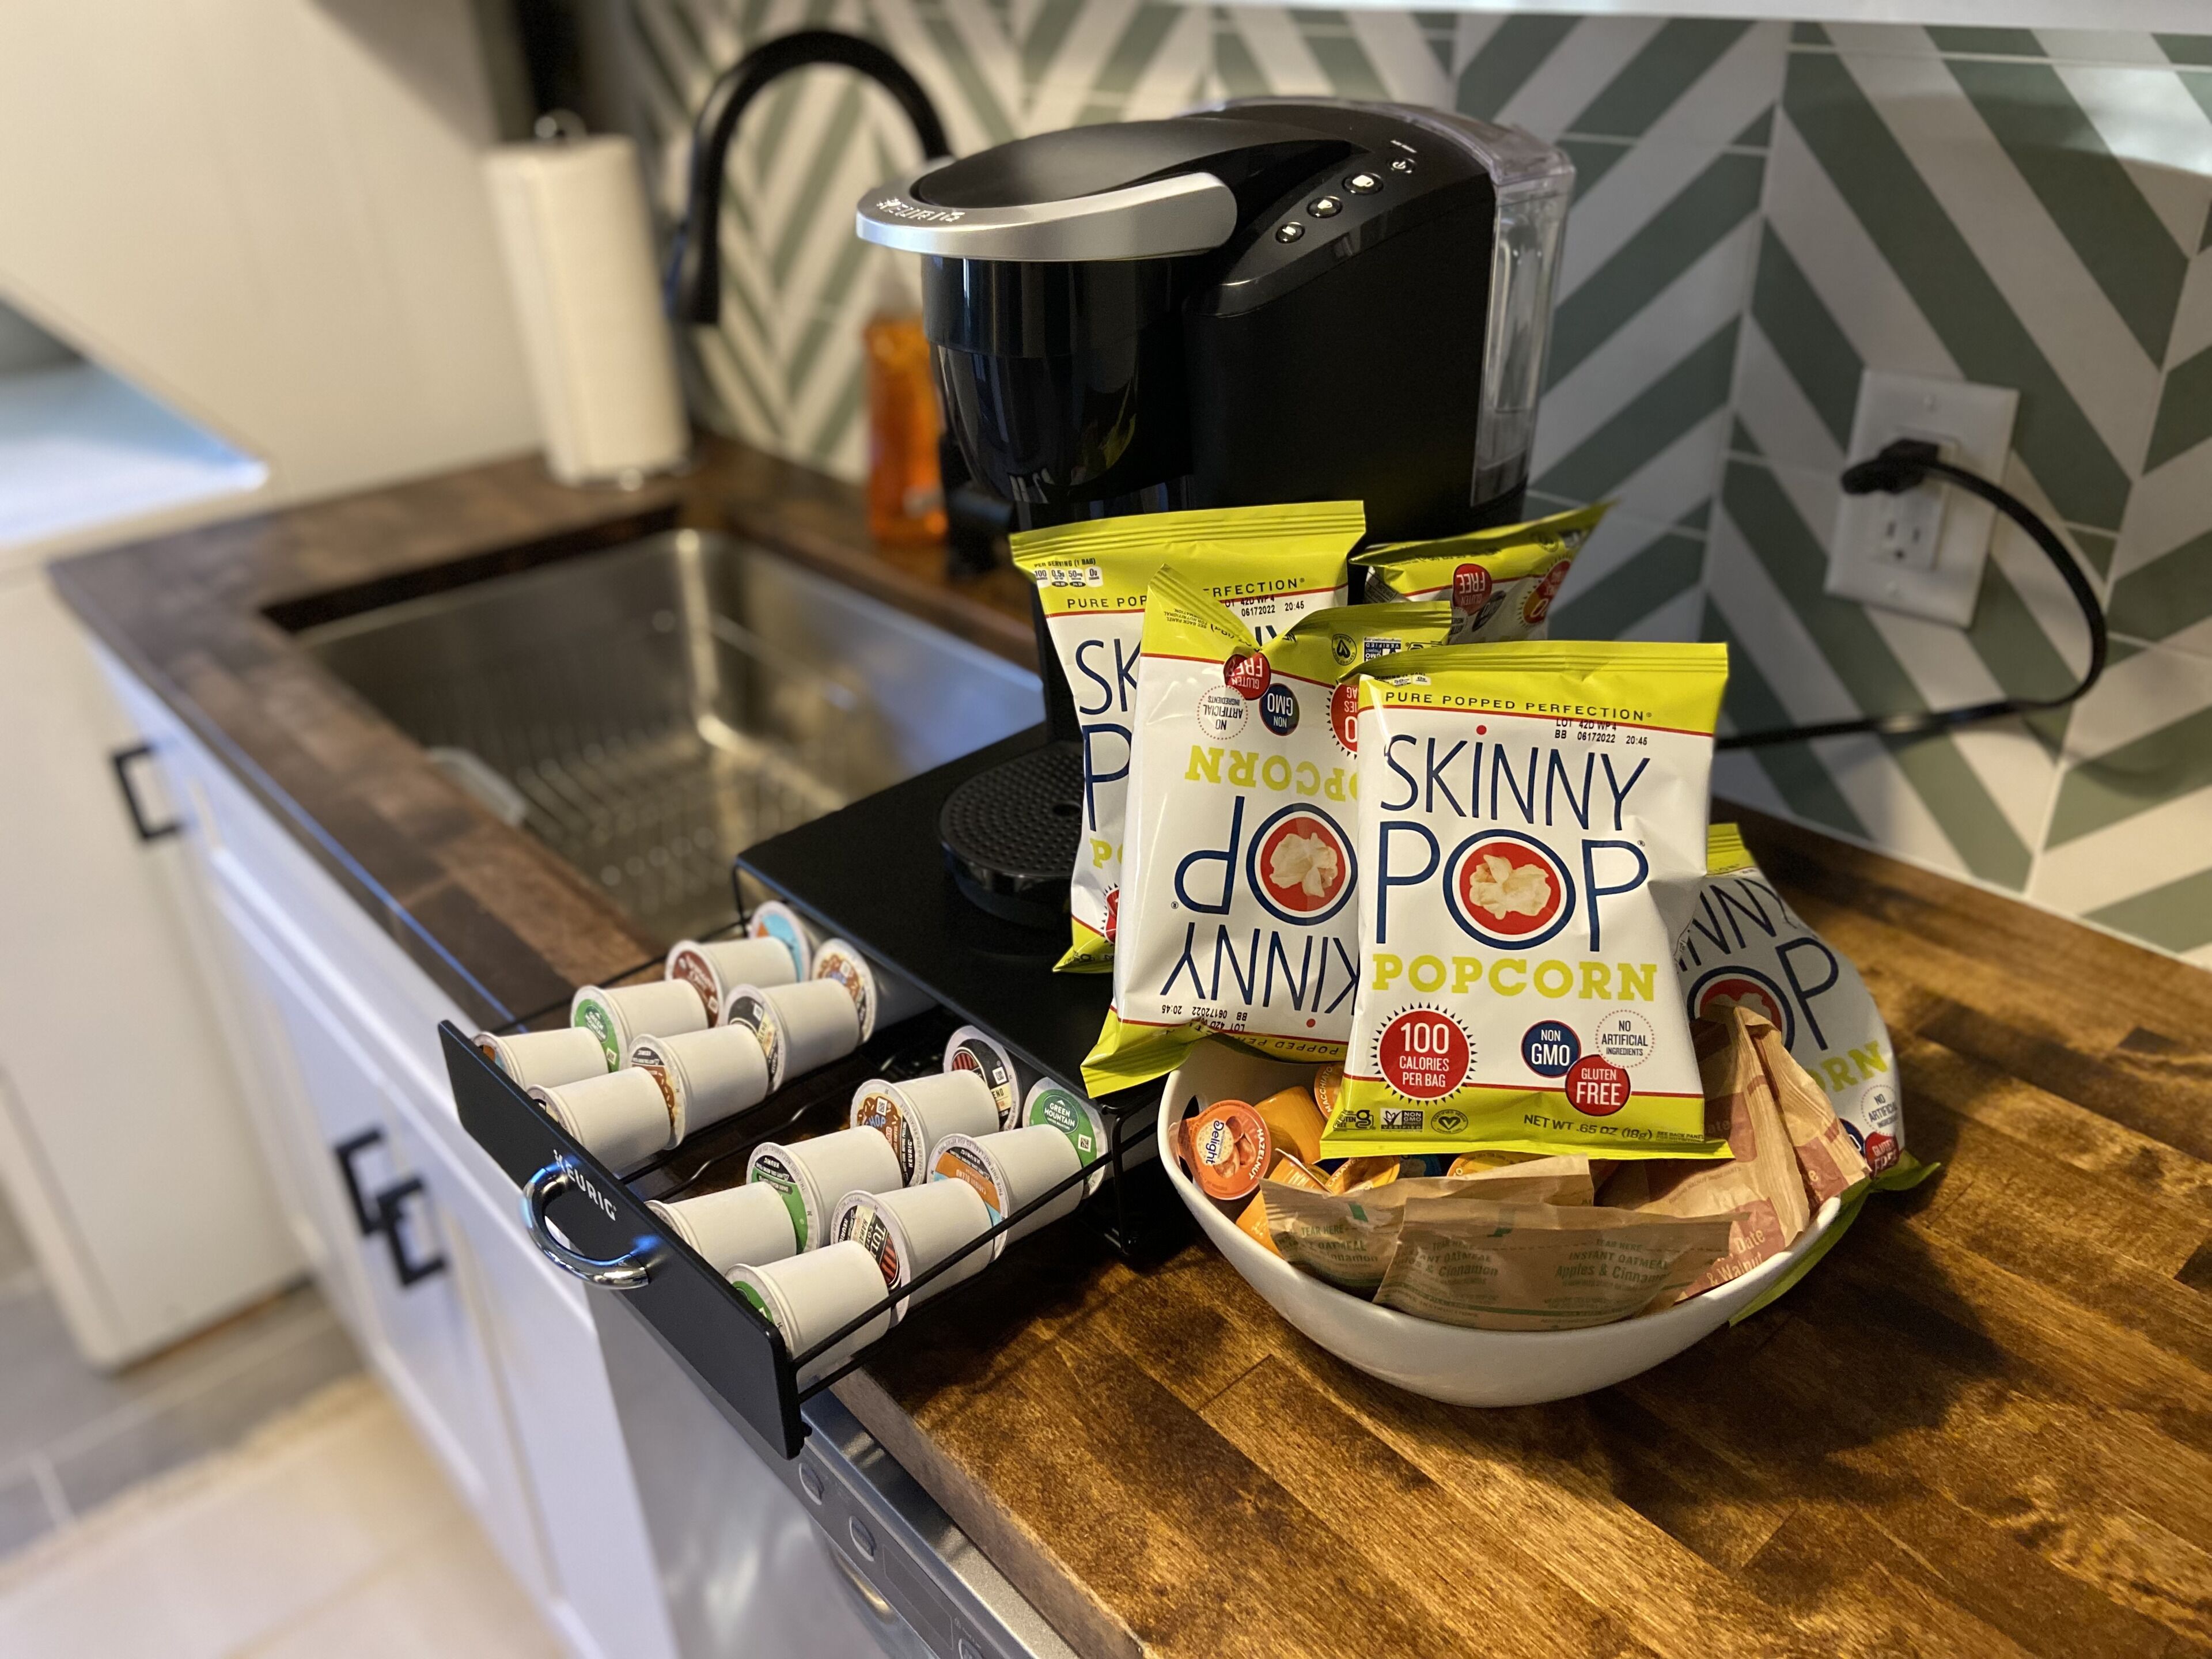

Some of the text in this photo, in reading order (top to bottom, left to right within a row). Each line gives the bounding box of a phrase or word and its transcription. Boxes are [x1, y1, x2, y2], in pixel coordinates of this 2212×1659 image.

[1048, 559, 1072, 567] SERVING
[1067, 598, 1109, 609] PURE
[1116, 595, 1147, 607] POP
[1241, 601, 1305, 617] 06172022 20:45
[1232, 676, 1260, 690] GLUTEN
[1207, 695, 1240, 706] INGREDIENTS
[1347, 687, 1357, 699] AG
[1385, 691, 1433, 703] PURE
[1442, 695, 1516, 710] POPPED
[1202, 704, 1244, 719] ARTIFICIAL
[1267, 692, 1294, 717] GMO
[1215, 719, 1227, 730] NO
[1273, 715, 1287, 728] NON
[1556, 718, 1573, 728] LOT
[1578, 719, 1594, 730] 42D
[1555, 729, 1567, 739] BB
[1577, 731, 1616, 744] 06172022
[1184, 745, 1358, 802] PCORN
[1174, 796, 1358, 926] OP
[1376, 820, 1649, 953] POP
[1372, 953, 1657, 1002] POPCORN
[1687, 937, 1839, 1054] OP
[1161, 1004, 1248, 1021] BB 06172022 20:45
[589, 1011, 604, 1031] GREEN
[1231, 1022, 1245, 1032] LOT
[1618, 1020, 1631, 1032] NO
[1400, 1022, 1449, 1054] 100
[1541, 1029, 1561, 1041] NON
[1601, 1034, 1649, 1047] ARTIFICIAL
[1275, 1040, 1339, 1055] POPPED
[1531, 1043, 1570, 1067] GMO
[1606, 1046, 1643, 1056] INGREDIENTS
[1399, 1055, 1449, 1072] CALORIES
[1402, 1072, 1446, 1088] PER BAG
[1581, 1067, 1618, 1081] GLUTEN
[992, 1088, 1004, 1099] END
[1318, 1066, 1333, 1113] MACCHIATO
[1575, 1081, 1622, 1106] FREE
[1873, 1093, 1886, 1105] NO
[1044, 1107, 1075, 1127] MOUNTAIN
[1050, 1103, 1070, 1117] GREEN
[1524, 1114, 1653, 1141] NET WT .65 OZ (18g)
[966, 1140, 983, 1155] LABELED
[1205, 1120, 1225, 1165] Delight
[960, 1149, 980, 1165] KEURIG
[983, 1156, 991, 1167] NOT
[1248, 1128, 1266, 1180] HAZELNUT
[956, 1169, 971, 1183] BLEND
[990, 1167, 999, 1180] UNIT
[553, 1149, 615, 1221] KEURIG
[1301, 1224, 1345, 1236] TEAR HERE
[1317, 1240, 1367, 1252] OATMEAL
[1735, 1228, 1766, 1254] Date
[1569, 1250, 1615, 1261] INSTANT
[1438, 1264, 1498, 1277] Cinnamon
[1557, 1264, 1608, 1278] Apples &
[1706, 1253, 1763, 1287] & Walnut
